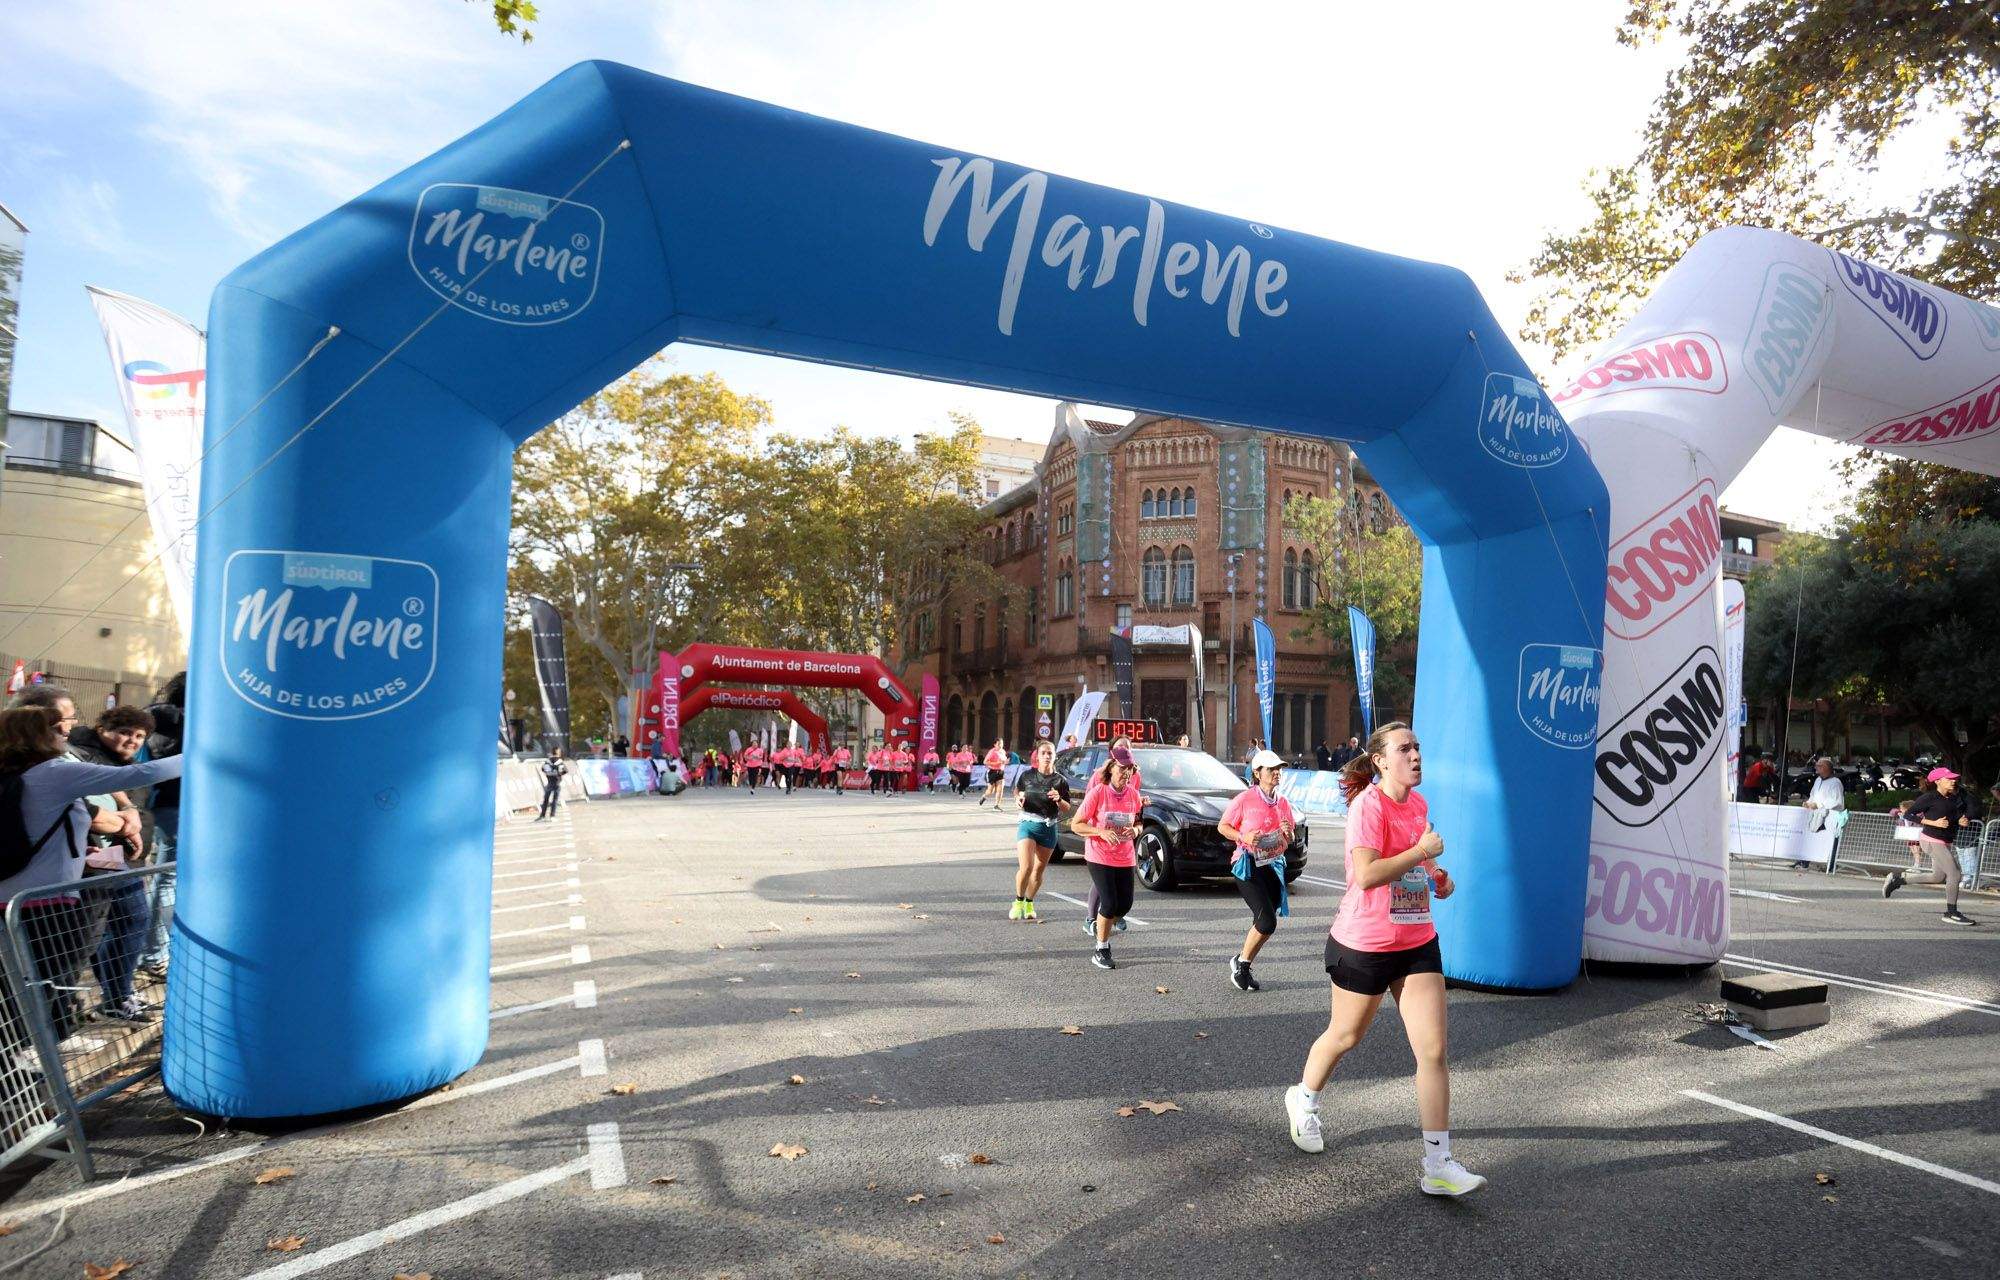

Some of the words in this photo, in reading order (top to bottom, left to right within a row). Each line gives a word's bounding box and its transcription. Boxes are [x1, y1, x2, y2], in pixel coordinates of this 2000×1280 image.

[424, 208, 588, 284] Marlene
[923, 157, 1289, 338] Marlene
[429, 266, 463, 299] HIJA
[465, 290, 487, 308] DE
[491, 301, 521, 316] LOS
[525, 298, 570, 317] ALPES
[1838, 252, 1939, 344] COSMO
[1754, 272, 1824, 397] COSMO
[1488, 394, 1562, 441] Marlene
[1488, 436, 1506, 456] HIJA
[1507, 450, 1521, 461] DE
[1522, 453, 1538, 463] LOS
[1606, 494, 1721, 621] COSMO
[232, 588, 424, 673] Marlene
[712, 655, 784, 669] Ajuntament
[787, 661, 801, 671] de
[804, 661, 861, 675] Barcelona
[238, 668, 273, 699] HIJA
[277, 690, 303, 708] DE
[308, 695, 346, 710] LOS
[351, 676, 408, 708] ALPES
[711, 692, 782, 708] elPeriódico
[1532, 715, 1553, 736] HIJA
[1555, 730, 1567, 741] DE
[1568, 734, 1583, 743] LOS
[1595, 662, 1724, 807] COSMO
[1584, 854, 1724, 946] COSMO
